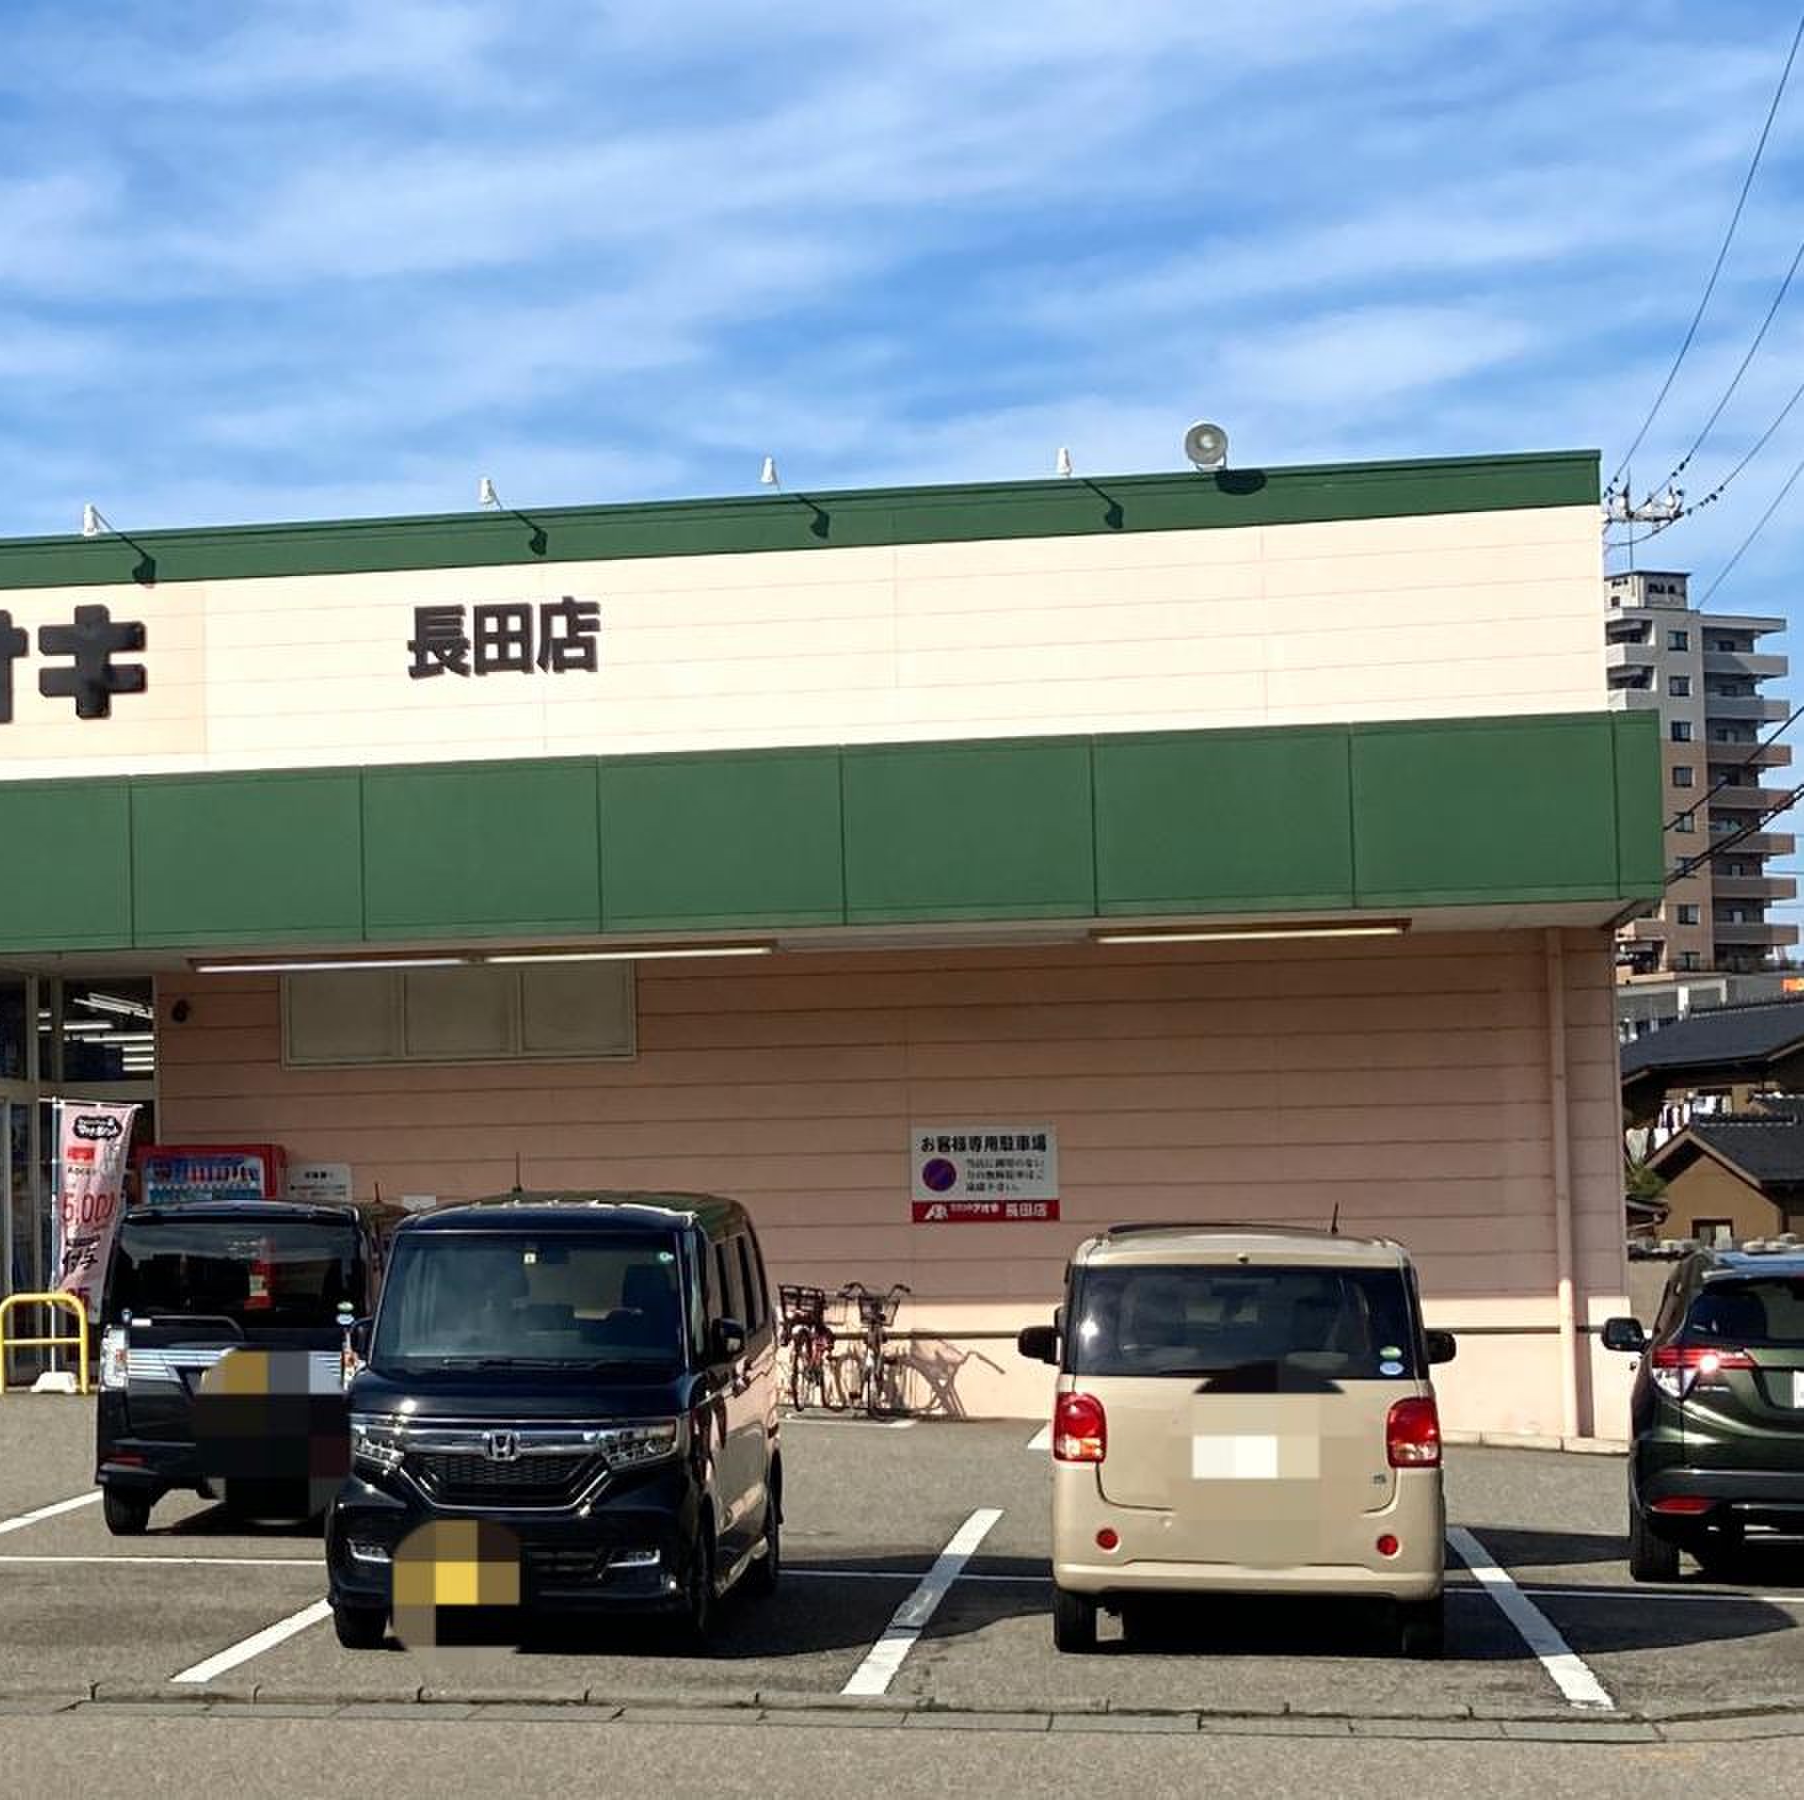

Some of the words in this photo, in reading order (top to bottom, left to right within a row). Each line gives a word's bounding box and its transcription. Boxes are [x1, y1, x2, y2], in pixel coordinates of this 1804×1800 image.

[407, 596, 601, 679] 長田店
[921, 1134, 1046, 1152] お客様専用駐車場
